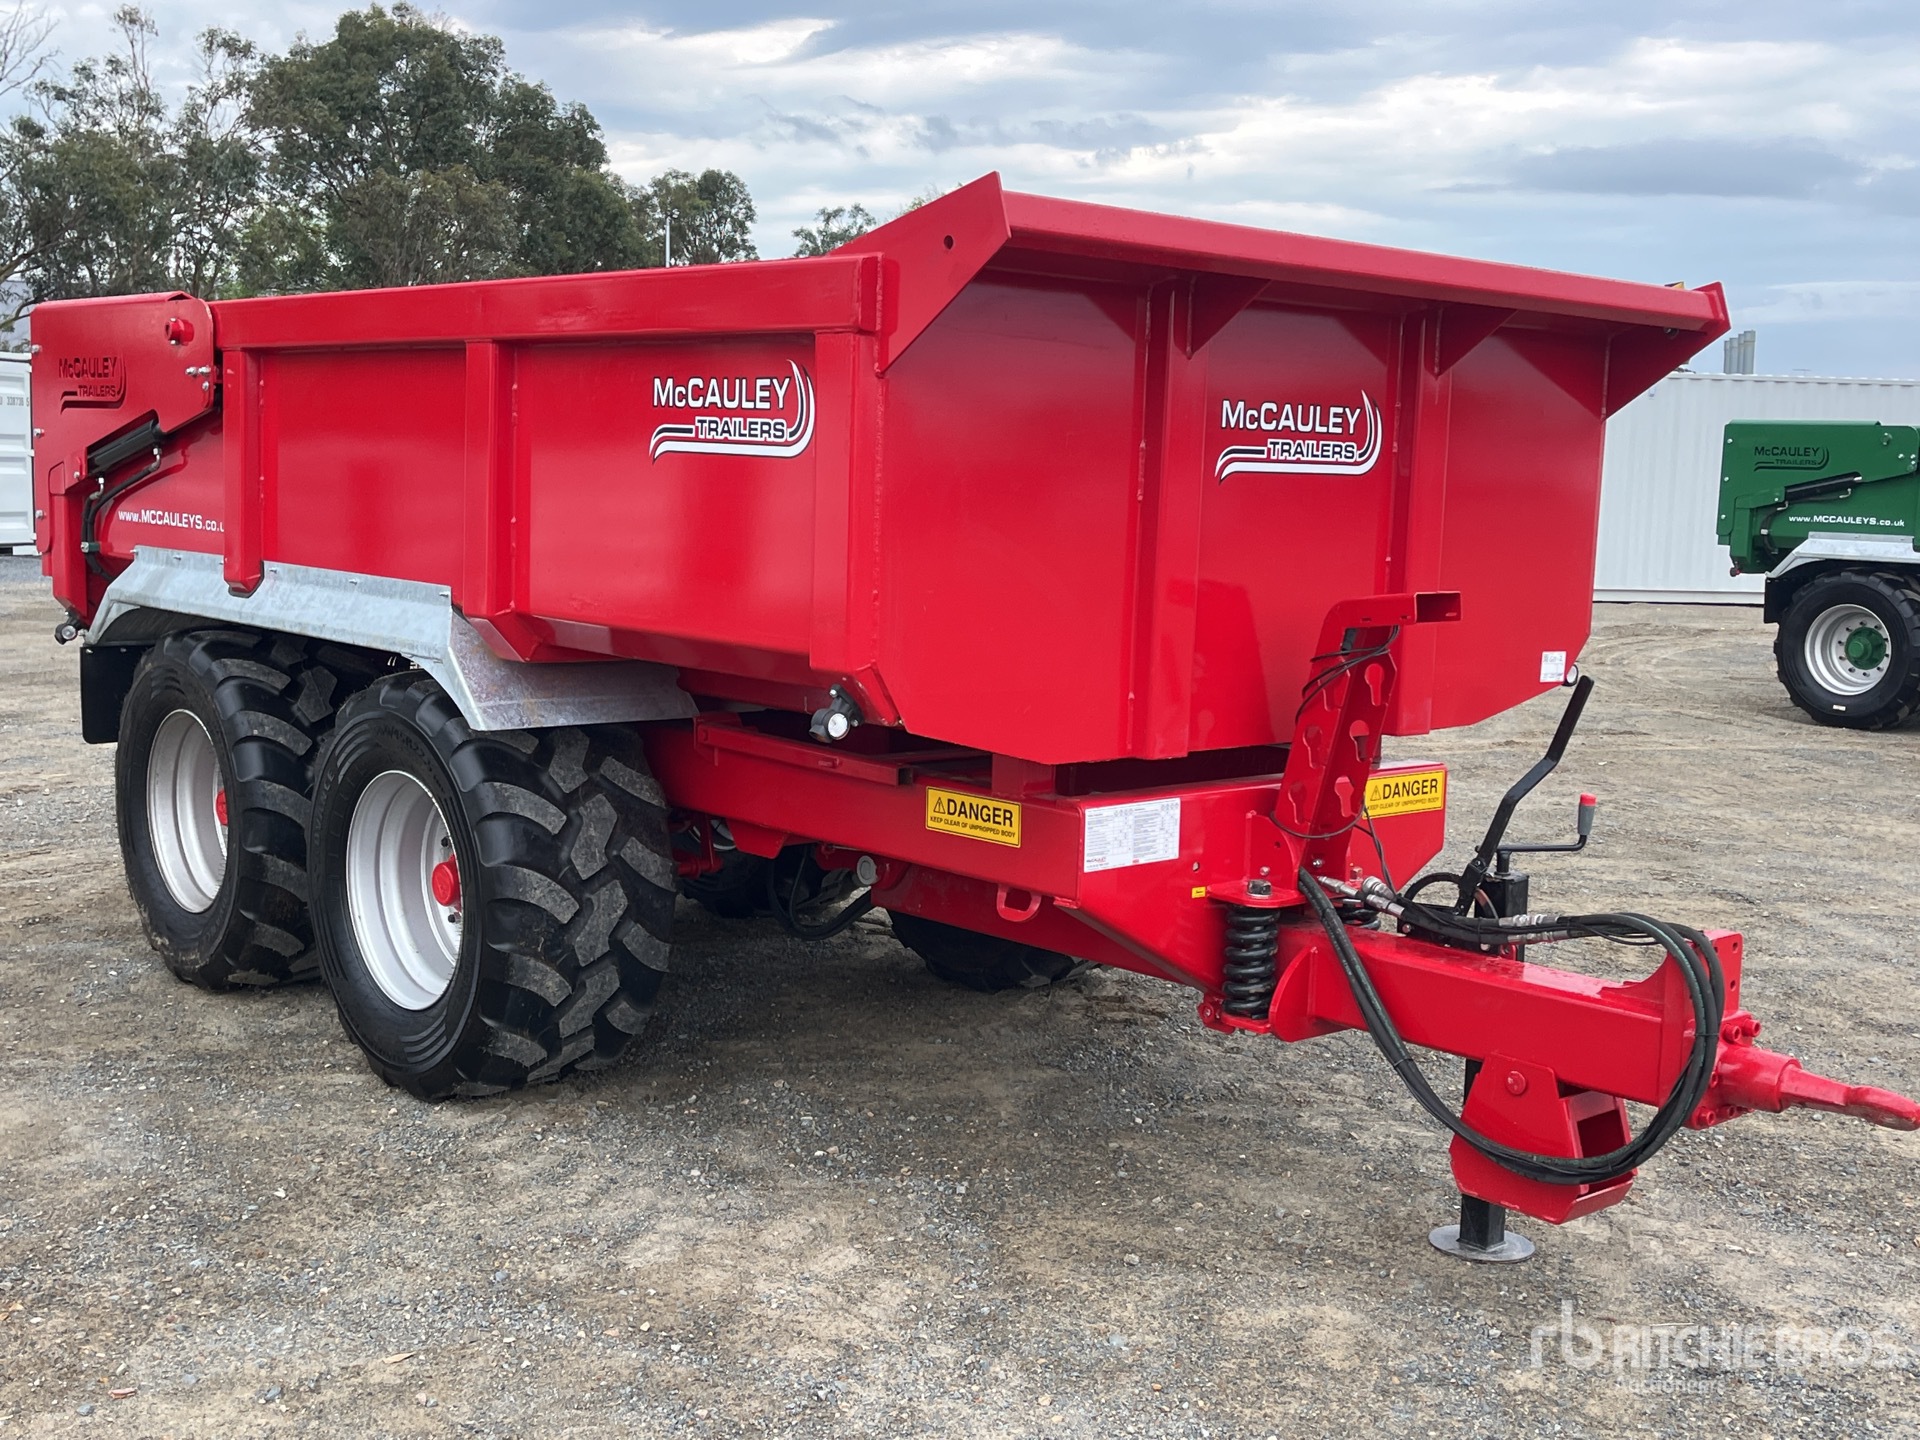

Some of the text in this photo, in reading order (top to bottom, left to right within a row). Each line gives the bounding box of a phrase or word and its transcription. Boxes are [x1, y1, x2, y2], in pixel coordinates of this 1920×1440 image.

[59, 356, 117, 378] McCAULEY
[78, 385, 116, 398] TRAILERS
[653, 377, 790, 410] McCAULEY
[1221, 399, 1361, 435] McCAULEY
[696, 418, 787, 440] TRAILERS
[1268, 440, 1357, 461] TRAILERS
[1754, 446, 1820, 457] McCAULEY
[1788, 515, 1905, 527] www.MCCAULEYS.co.uk
[1383, 779, 1438, 800] DANGER
[947, 798, 1013, 828] DANGER
[930, 815, 943, 824] KEEP
[944, 818, 960, 828] CLEAR
[961, 821, 968, 829] OF
[1001, 829, 1015, 838] BODY
